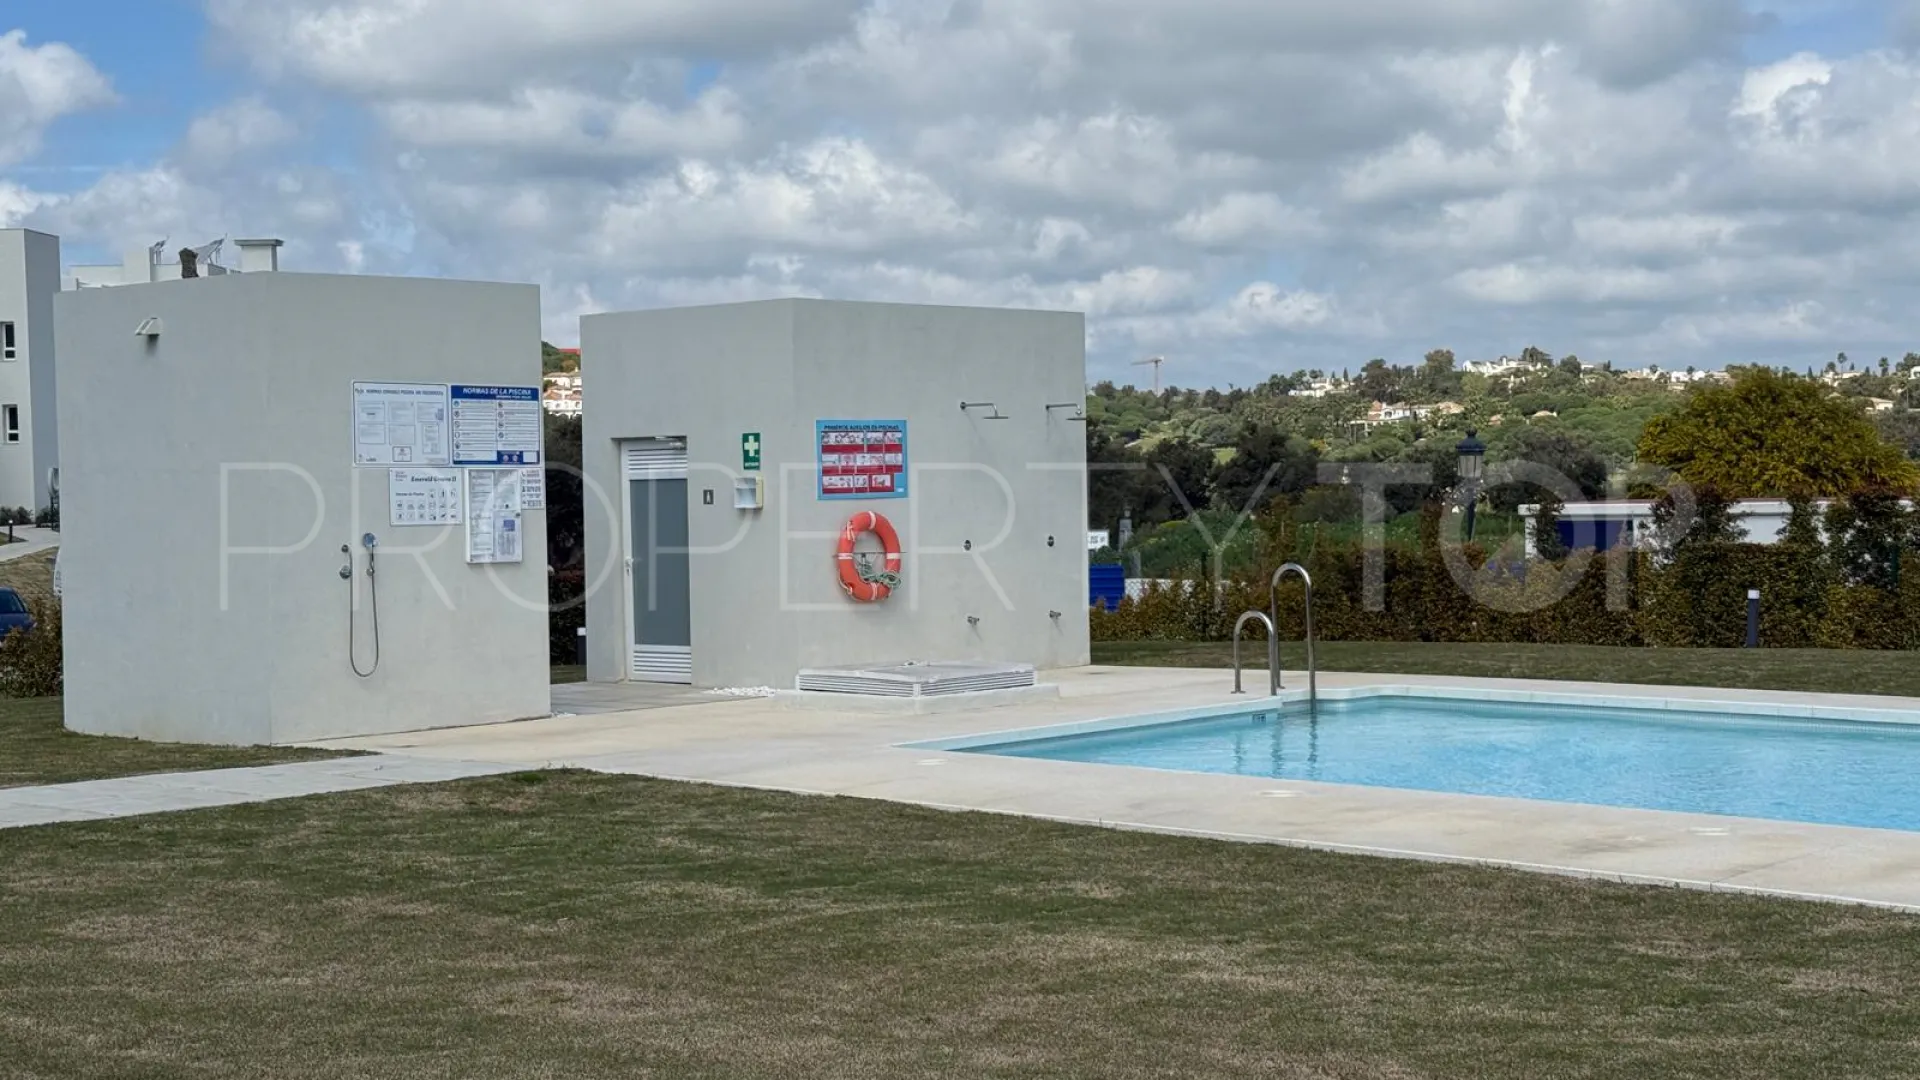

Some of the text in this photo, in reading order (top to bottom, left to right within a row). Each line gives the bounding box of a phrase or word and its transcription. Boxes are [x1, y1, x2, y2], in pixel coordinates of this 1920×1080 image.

[462, 387, 489, 395] NORMAS
[500, 388, 508, 396] LA
[508, 388, 532, 396] PISCINA
